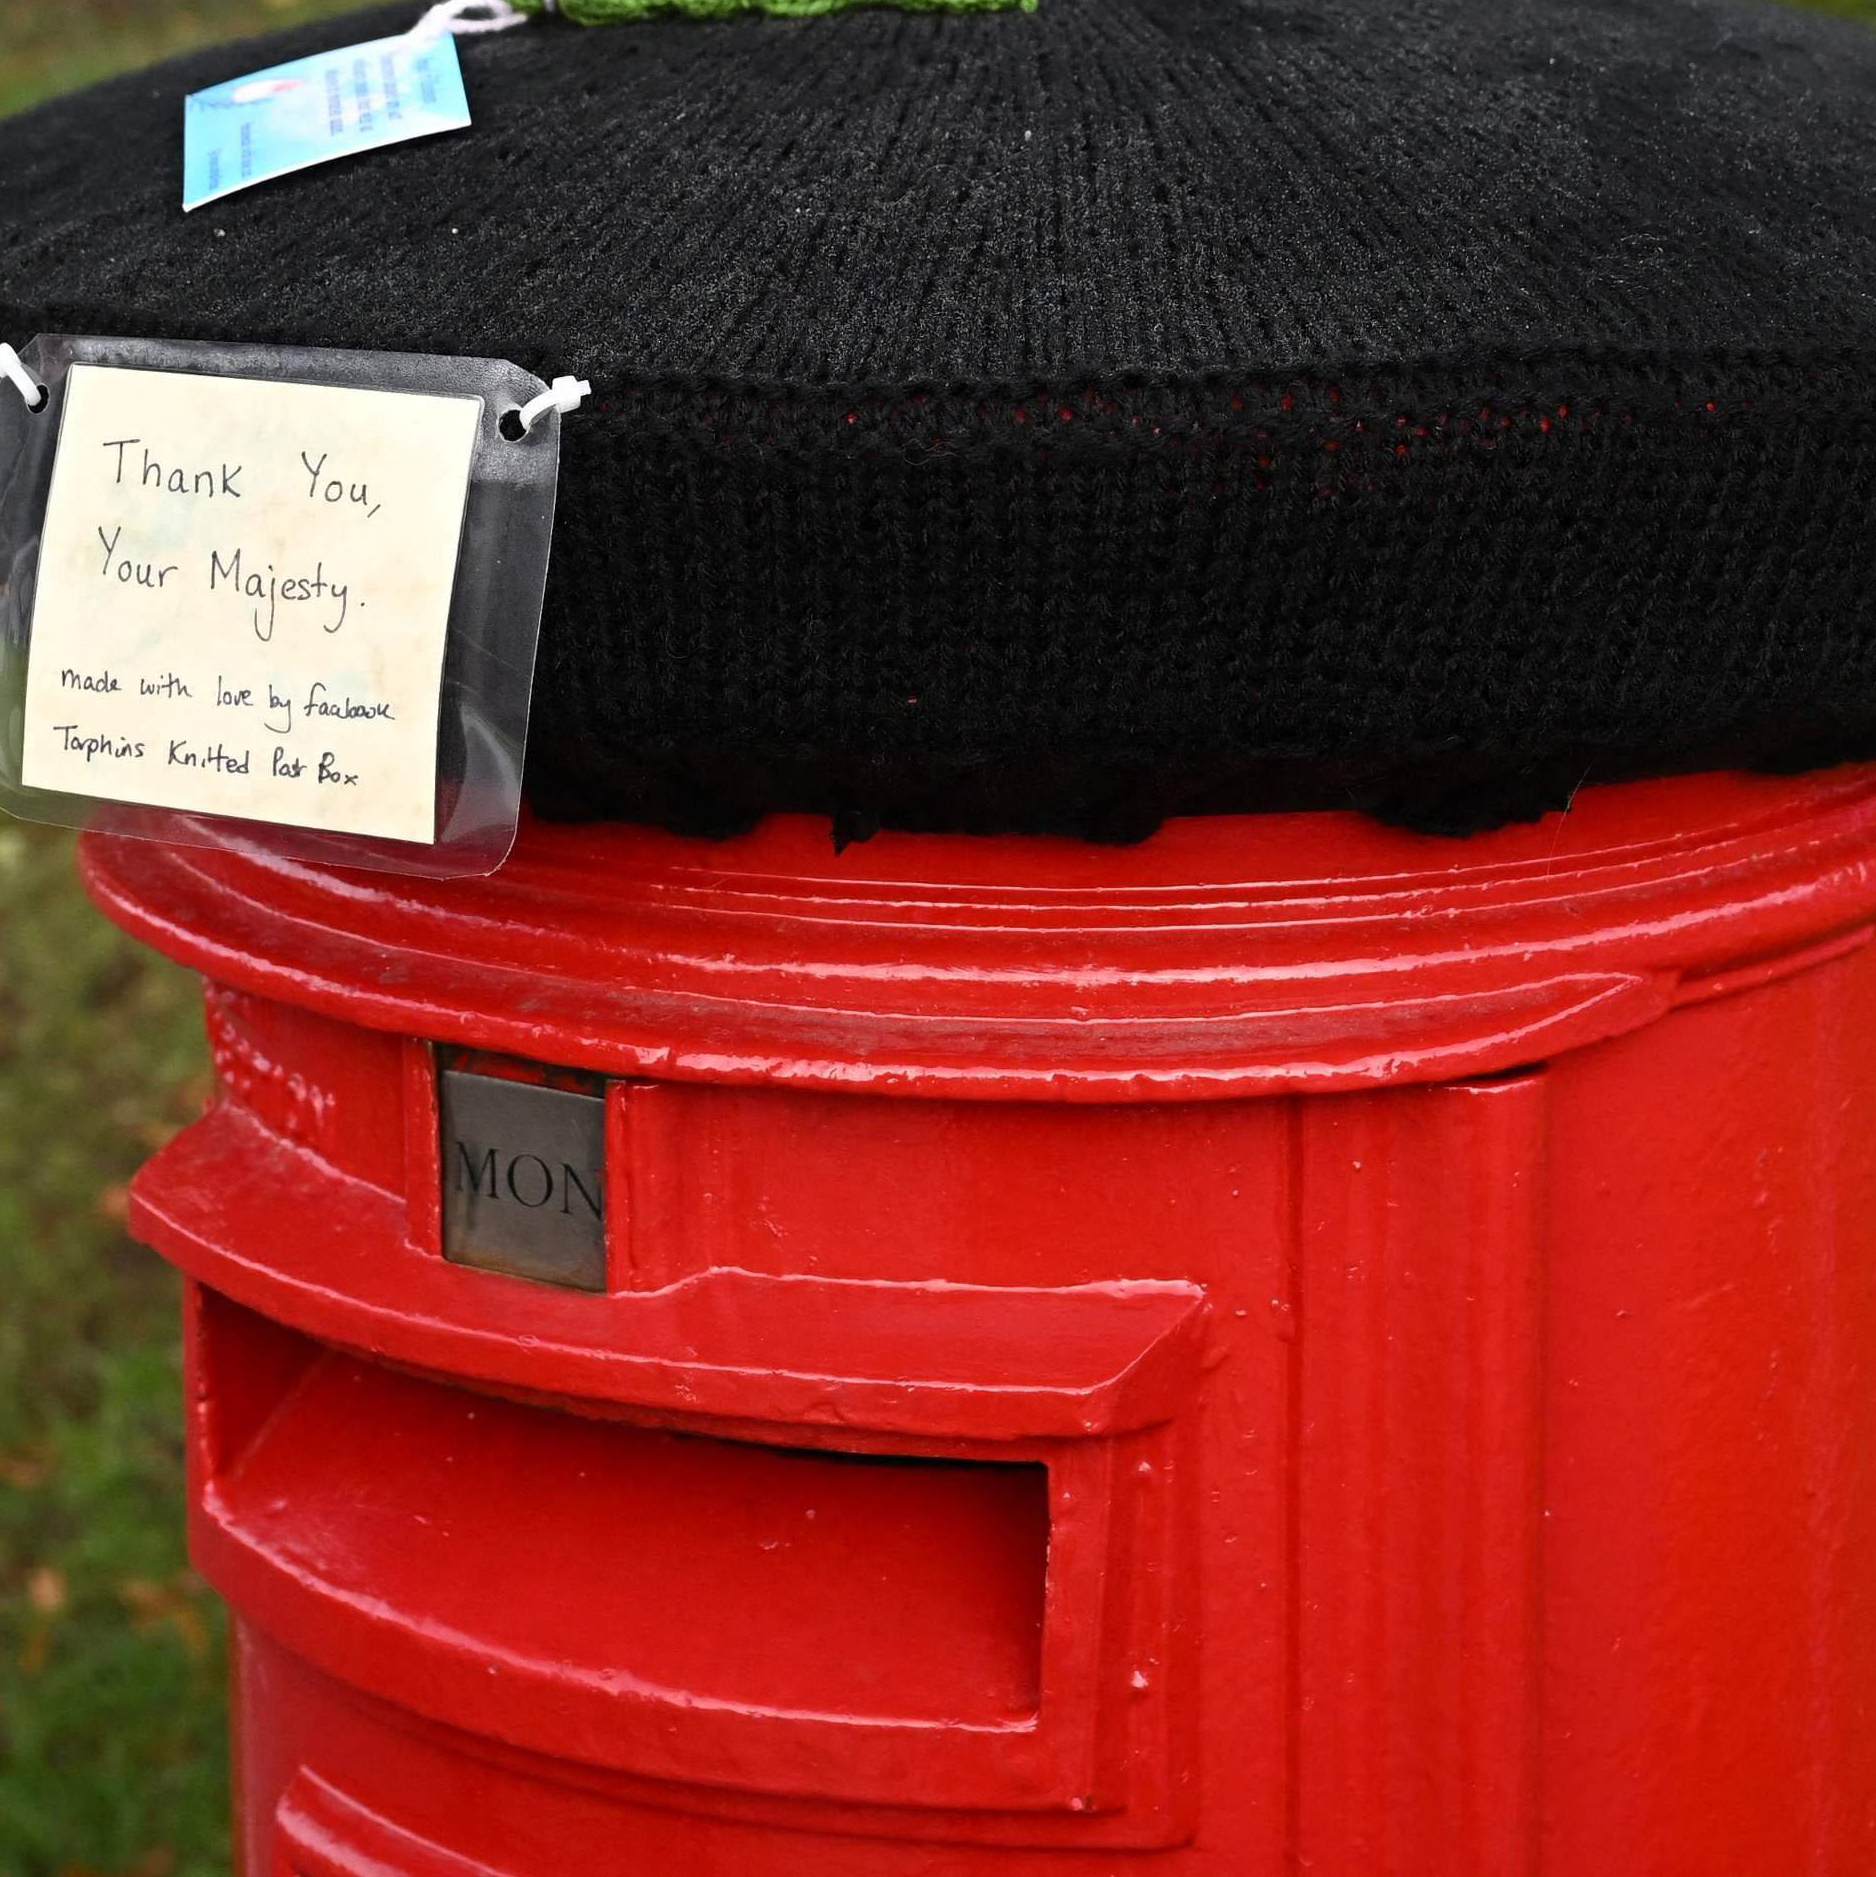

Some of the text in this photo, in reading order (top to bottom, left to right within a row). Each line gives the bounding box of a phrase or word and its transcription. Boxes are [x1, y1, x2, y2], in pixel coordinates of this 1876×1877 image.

[102, 438, 381, 519] Thank You,
[97, 525, 366, 642] Your Majesty.
[61, 668, 123, 694] made
[139, 672, 193, 699] with
[216, 674, 254, 707] love
[263, 683, 292, 734] by
[167, 739, 250, 775] Knitted
[317, 751, 359, 787] Box
[454, 1141, 604, 1222] MON
